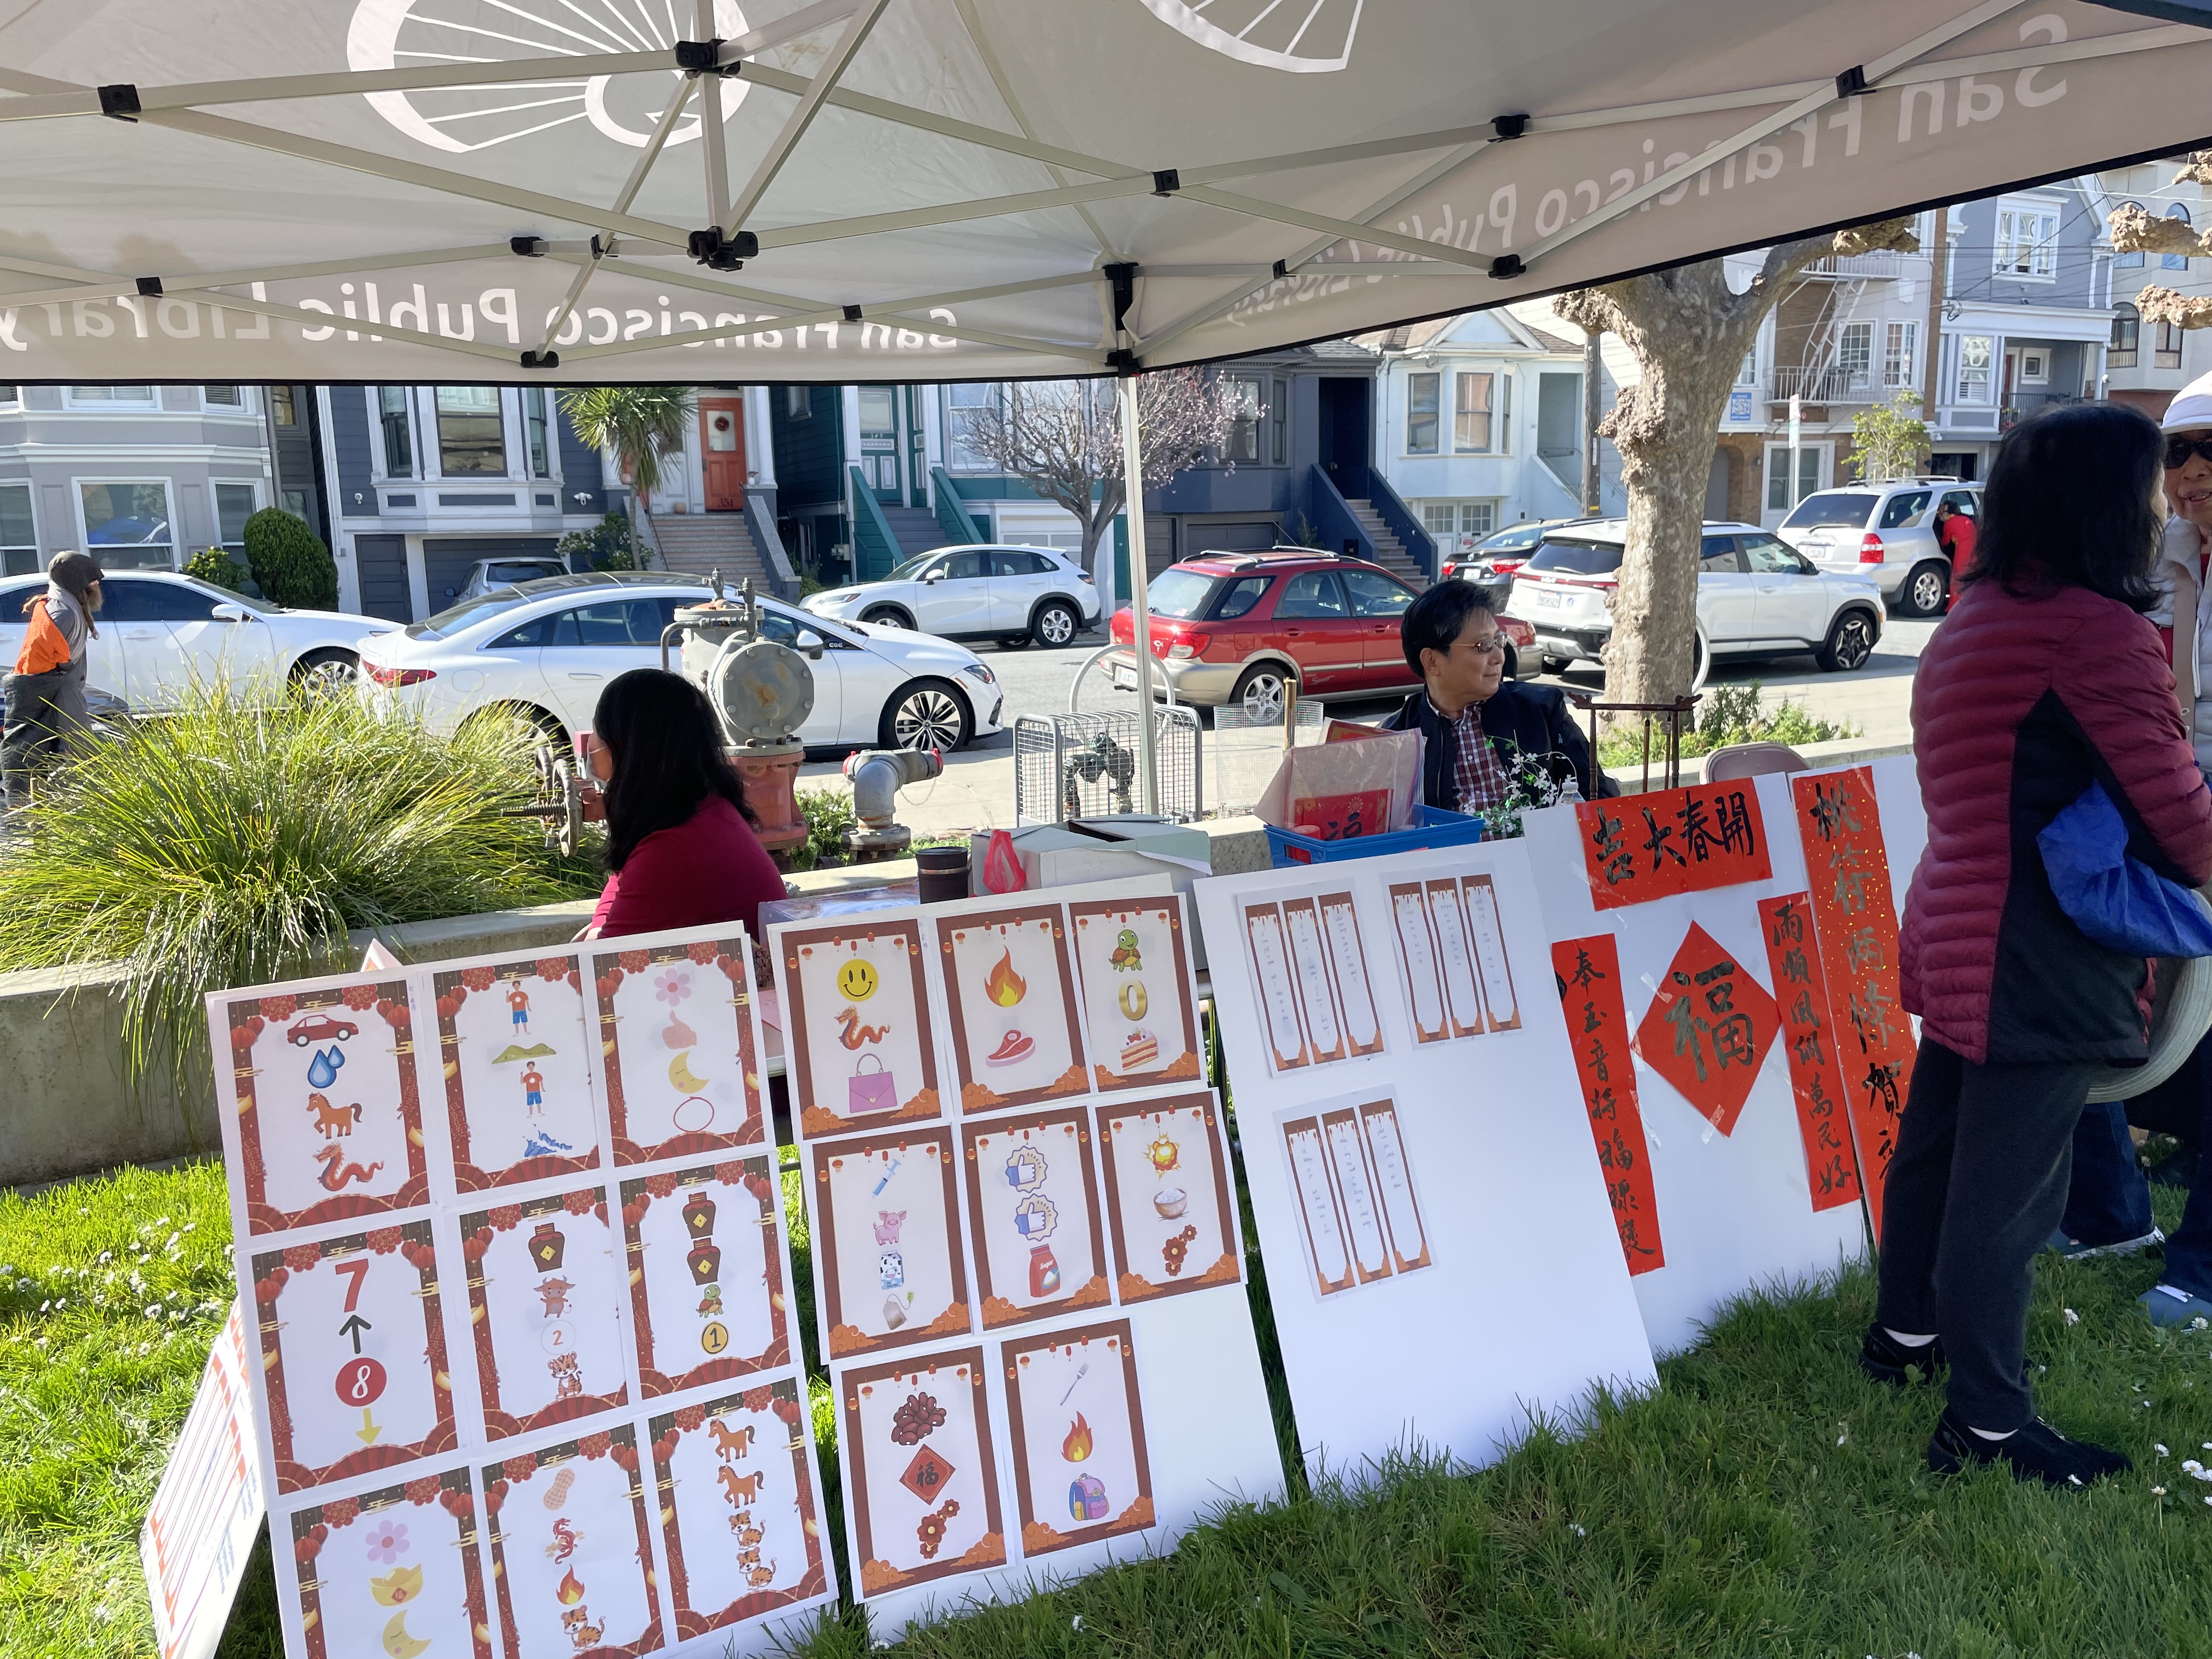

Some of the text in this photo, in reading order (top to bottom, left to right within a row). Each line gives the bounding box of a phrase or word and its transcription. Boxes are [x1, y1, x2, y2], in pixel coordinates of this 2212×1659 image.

[1664, 961, 1753, 1083] 福
[1040, 1259, 1054, 1270] Sugar
[335, 1259, 369, 1313] 7
[552, 1330, 564, 1346] 2
[709, 1328, 721, 1348] 1
[352, 1365, 371, 1400] 8
[916, 1462, 939, 1488] 福
